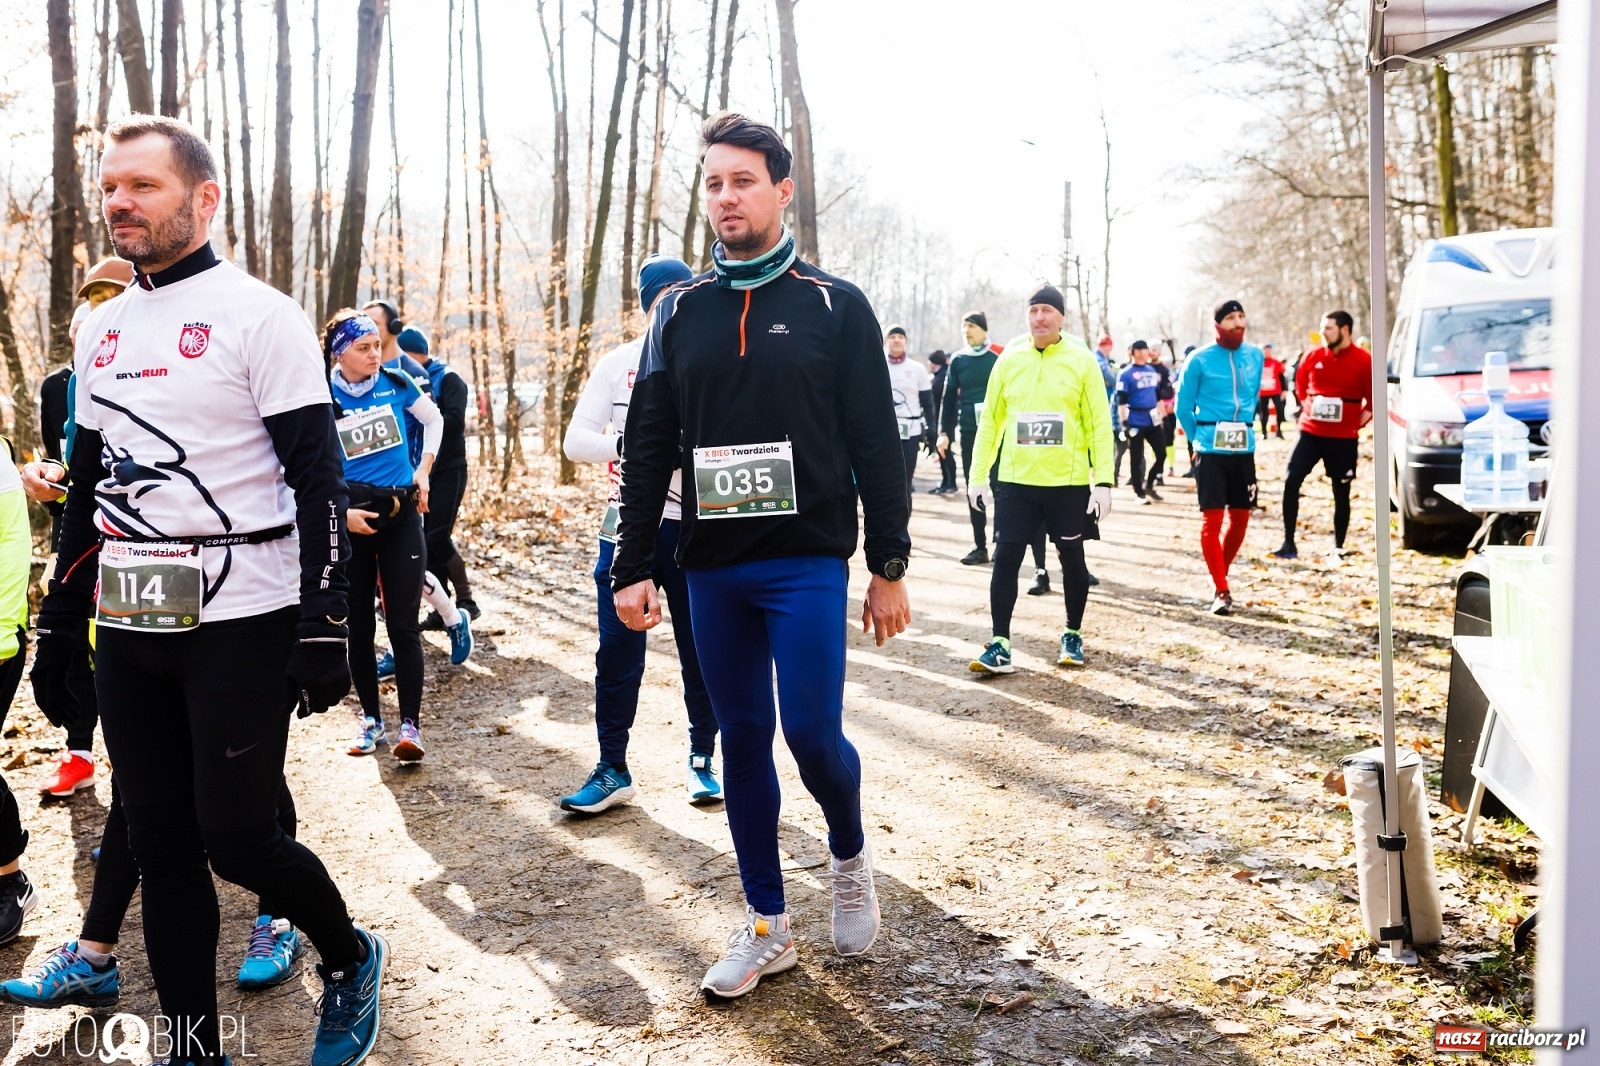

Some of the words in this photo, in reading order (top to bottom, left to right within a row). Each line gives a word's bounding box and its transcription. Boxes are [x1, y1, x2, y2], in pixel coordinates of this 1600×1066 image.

[351, 420, 388, 445] 078
[1027, 422, 1053, 437] 127
[1224, 431, 1244, 443] 124
[704, 450, 710, 458] X
[711, 449, 730, 458] BIEG
[730, 446, 780, 456] Twardziela
[714, 467, 774, 496] 035
[111, 545, 127, 555] BIEG
[127, 547, 187, 558] Twardziela
[117, 571, 166, 606] 114
